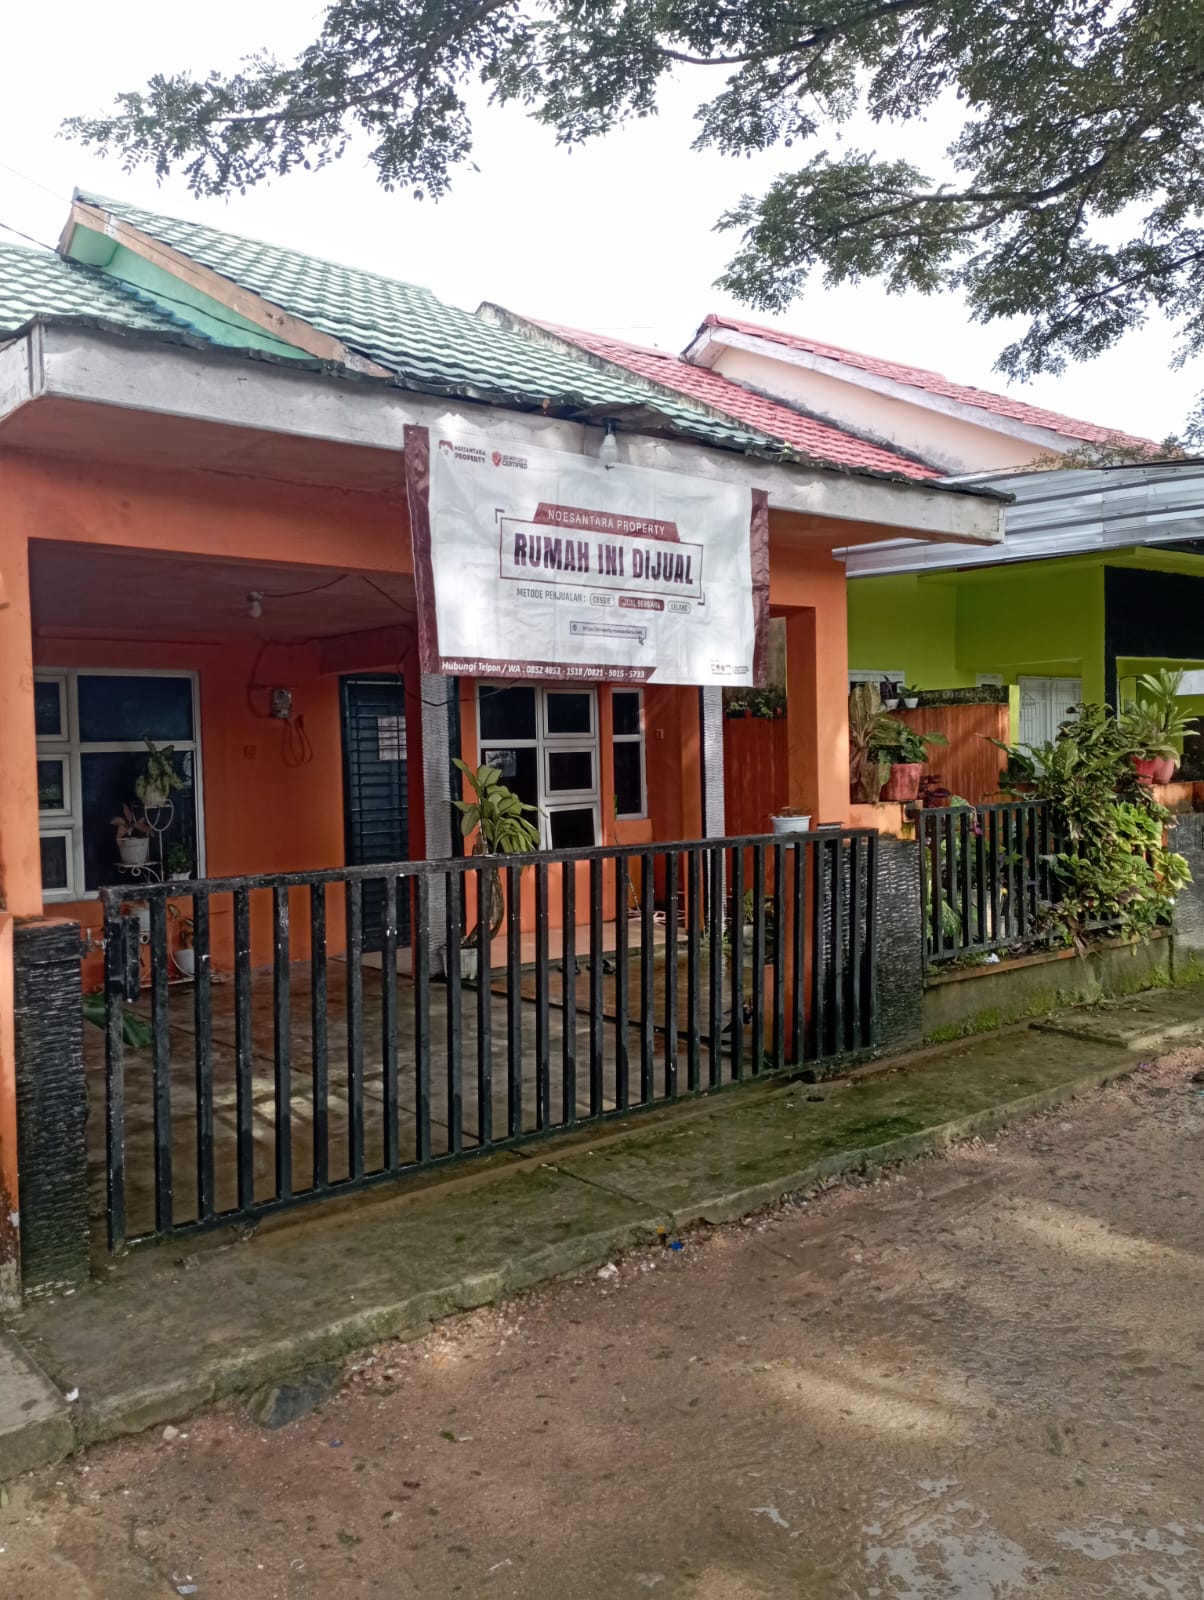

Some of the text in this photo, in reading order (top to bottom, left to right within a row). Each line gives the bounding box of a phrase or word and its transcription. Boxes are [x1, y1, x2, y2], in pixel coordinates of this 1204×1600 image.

[454, 452, 486, 463] PROPERTY
[547, 509, 665, 536] NOESANTARA PROPERTY
[514, 532, 693, 585] RUMAH INI DIJUAL
[516, 587, 543, 599] METODE
[545, 590, 582, 602] PENJUALAN
[441, 661, 477, 673] Hubungi
[478, 662, 500, 673] Telpon
[501, 663, 508, 674] /
[508, 664, 521, 673] WA
[526, 665, 542, 674] 0852
[608, 669, 624, 677] 5015
